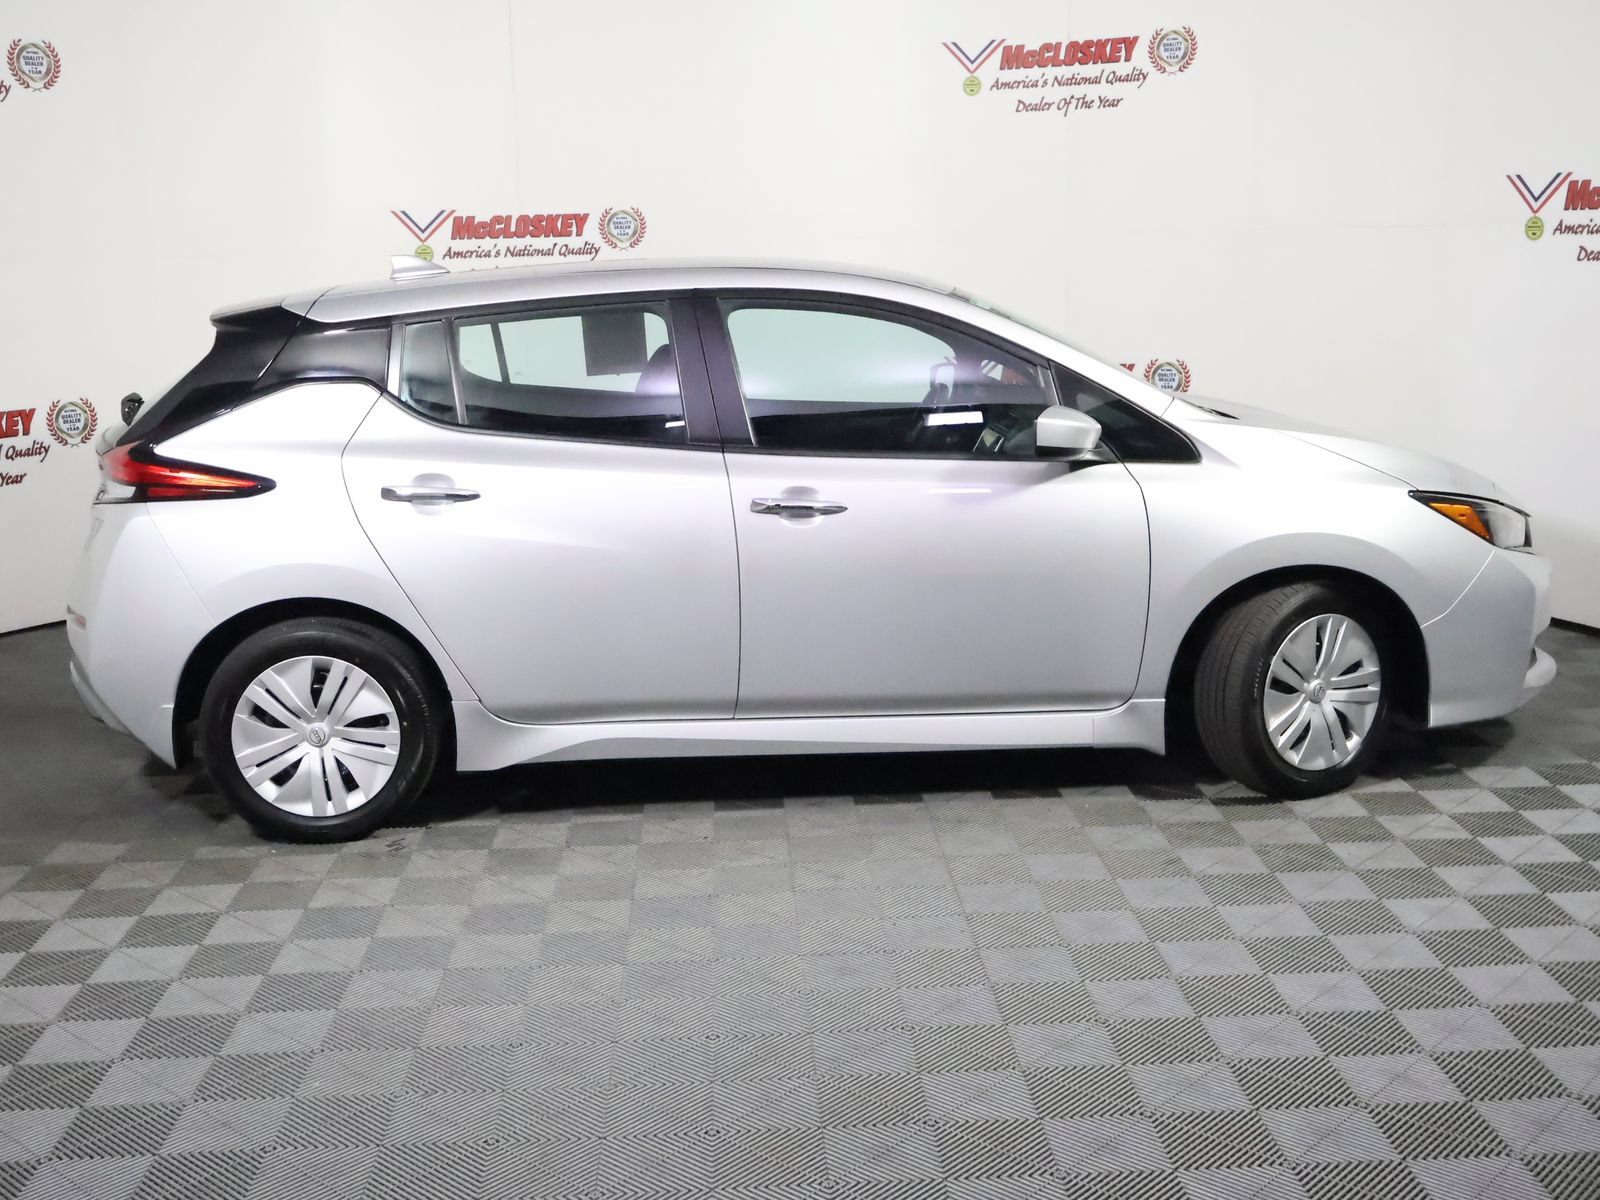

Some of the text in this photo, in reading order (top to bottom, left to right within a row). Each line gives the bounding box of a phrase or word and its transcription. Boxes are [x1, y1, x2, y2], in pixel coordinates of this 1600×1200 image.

[999, 36, 1140, 70] McCLOSKEY
[989, 72, 1049, 91] America's
[1051, 68, 1105, 87] National
[1105, 66, 1149, 89] Quality
[1015, 93, 1124, 117] Dealer Of The Year
[450, 213, 590, 241] McCLOSKEY
[442, 243, 501, 260] America's
[504, 242, 557, 258] National
[558, 240, 601, 261] Quality
[5, 440, 50, 463] Quality
